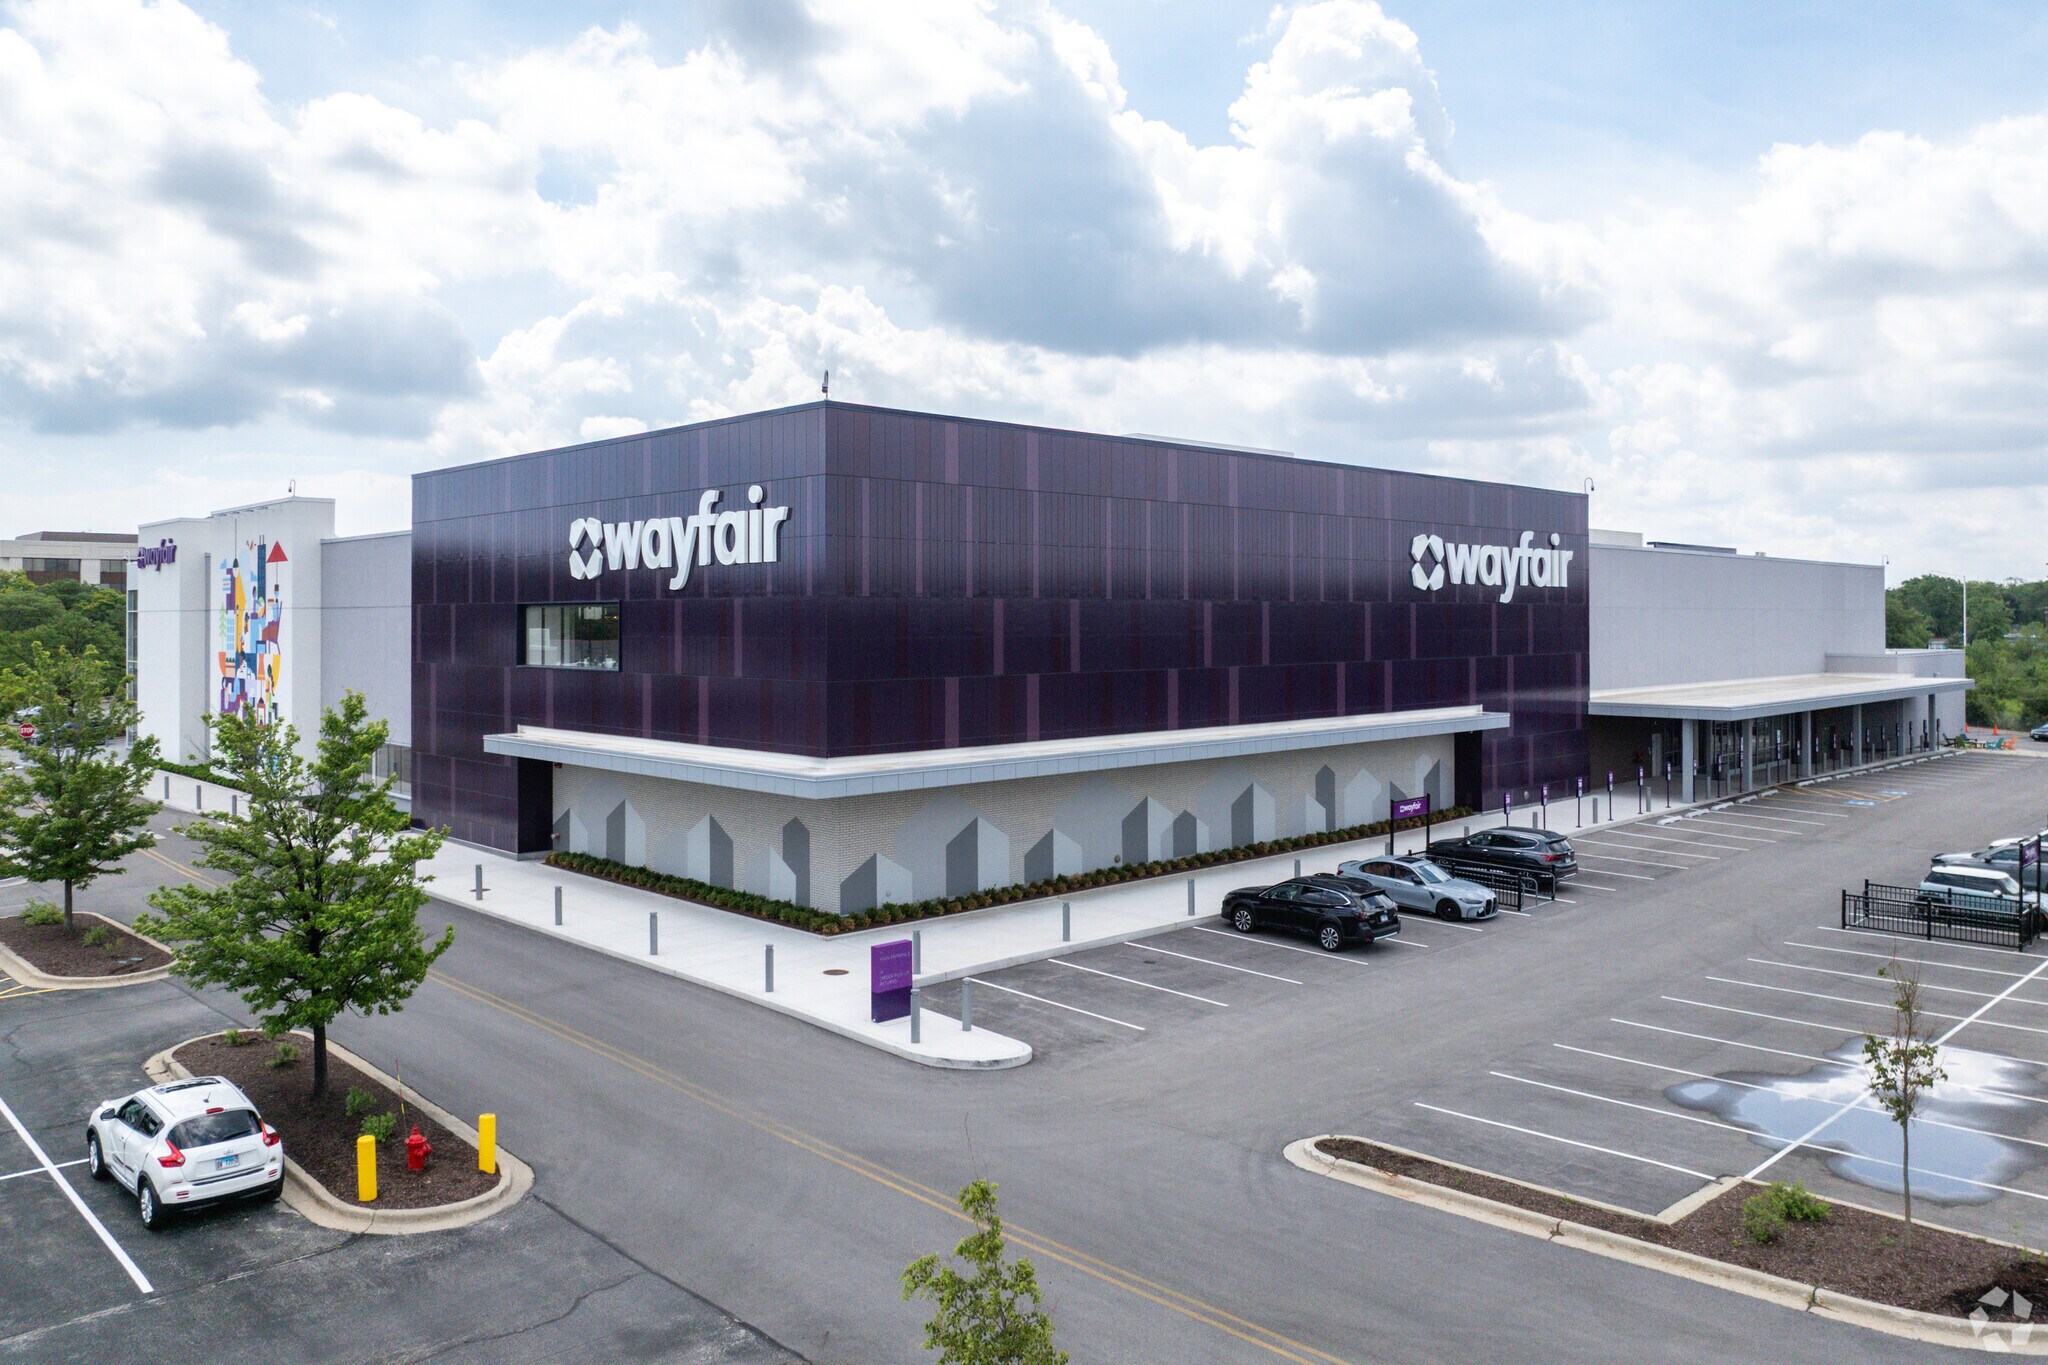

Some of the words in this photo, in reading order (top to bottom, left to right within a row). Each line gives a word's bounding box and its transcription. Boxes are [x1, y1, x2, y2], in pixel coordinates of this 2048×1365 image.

[145, 538, 177, 571] wayfair
[603, 485, 789, 591] wayfair
[1445, 531, 1574, 604] wayfair
[1404, 801, 1421, 812] wayfair
